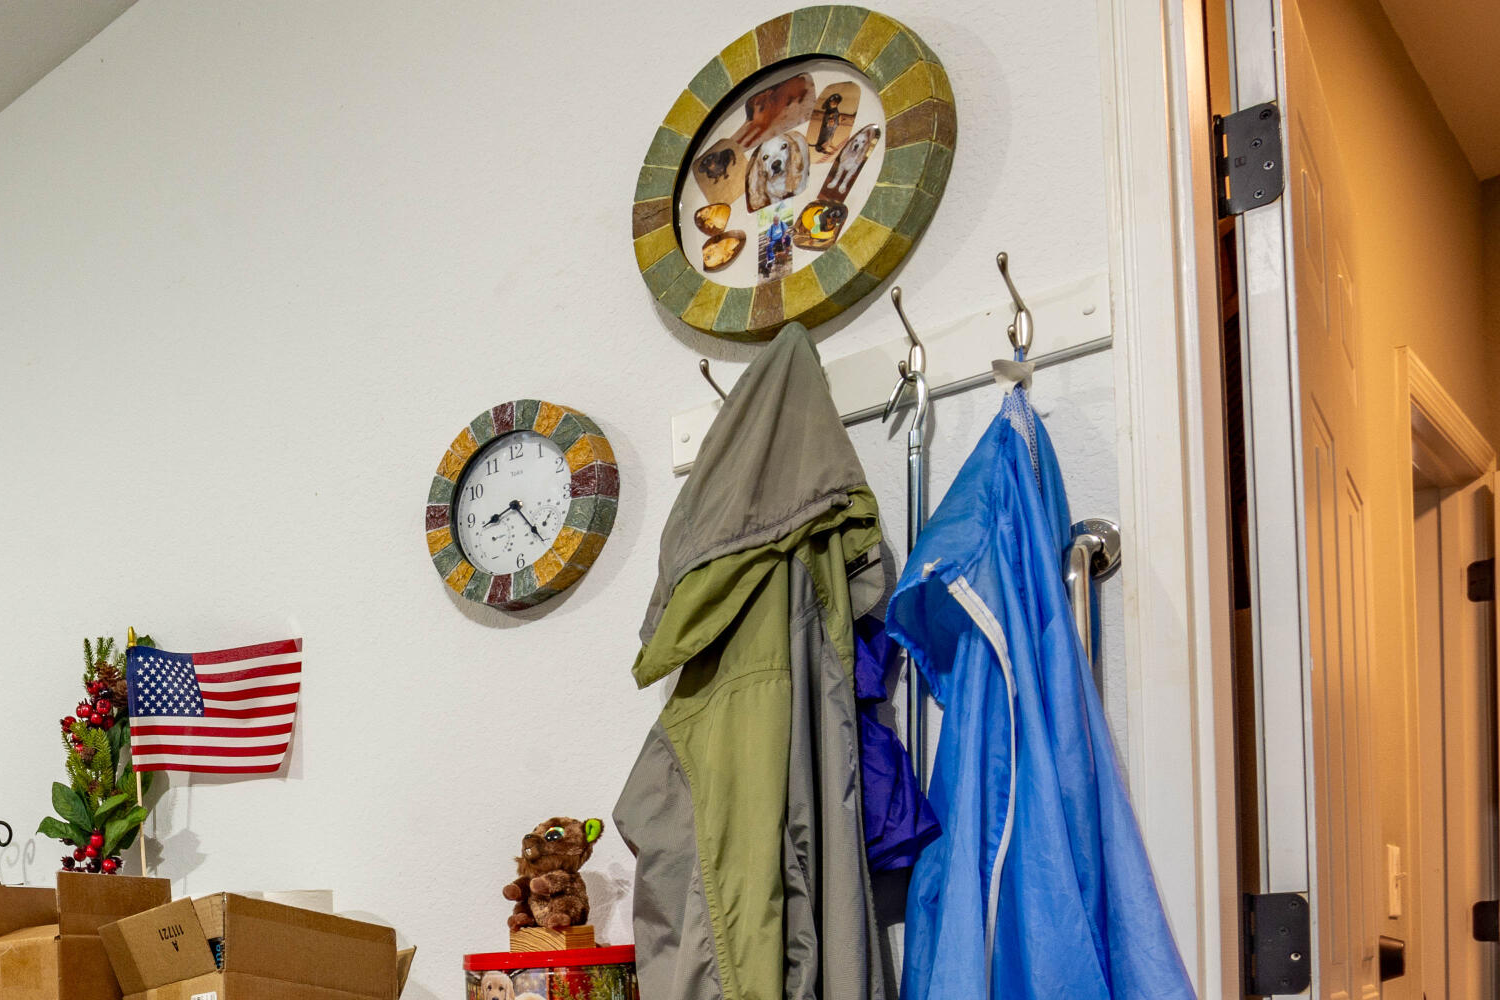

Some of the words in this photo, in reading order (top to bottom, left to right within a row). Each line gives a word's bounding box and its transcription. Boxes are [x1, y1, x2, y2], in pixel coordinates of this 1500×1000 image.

[508, 442, 524, 461] 12
[537, 442, 543, 459] 1
[486, 458, 499, 476] 11
[555, 456, 565, 474] 2
[469, 483, 484, 501] 10
[563, 483, 572, 499] 3
[467, 513, 476, 528] 9
[516, 553, 525, 568] 6
[158, 924, 184, 941] 111721
